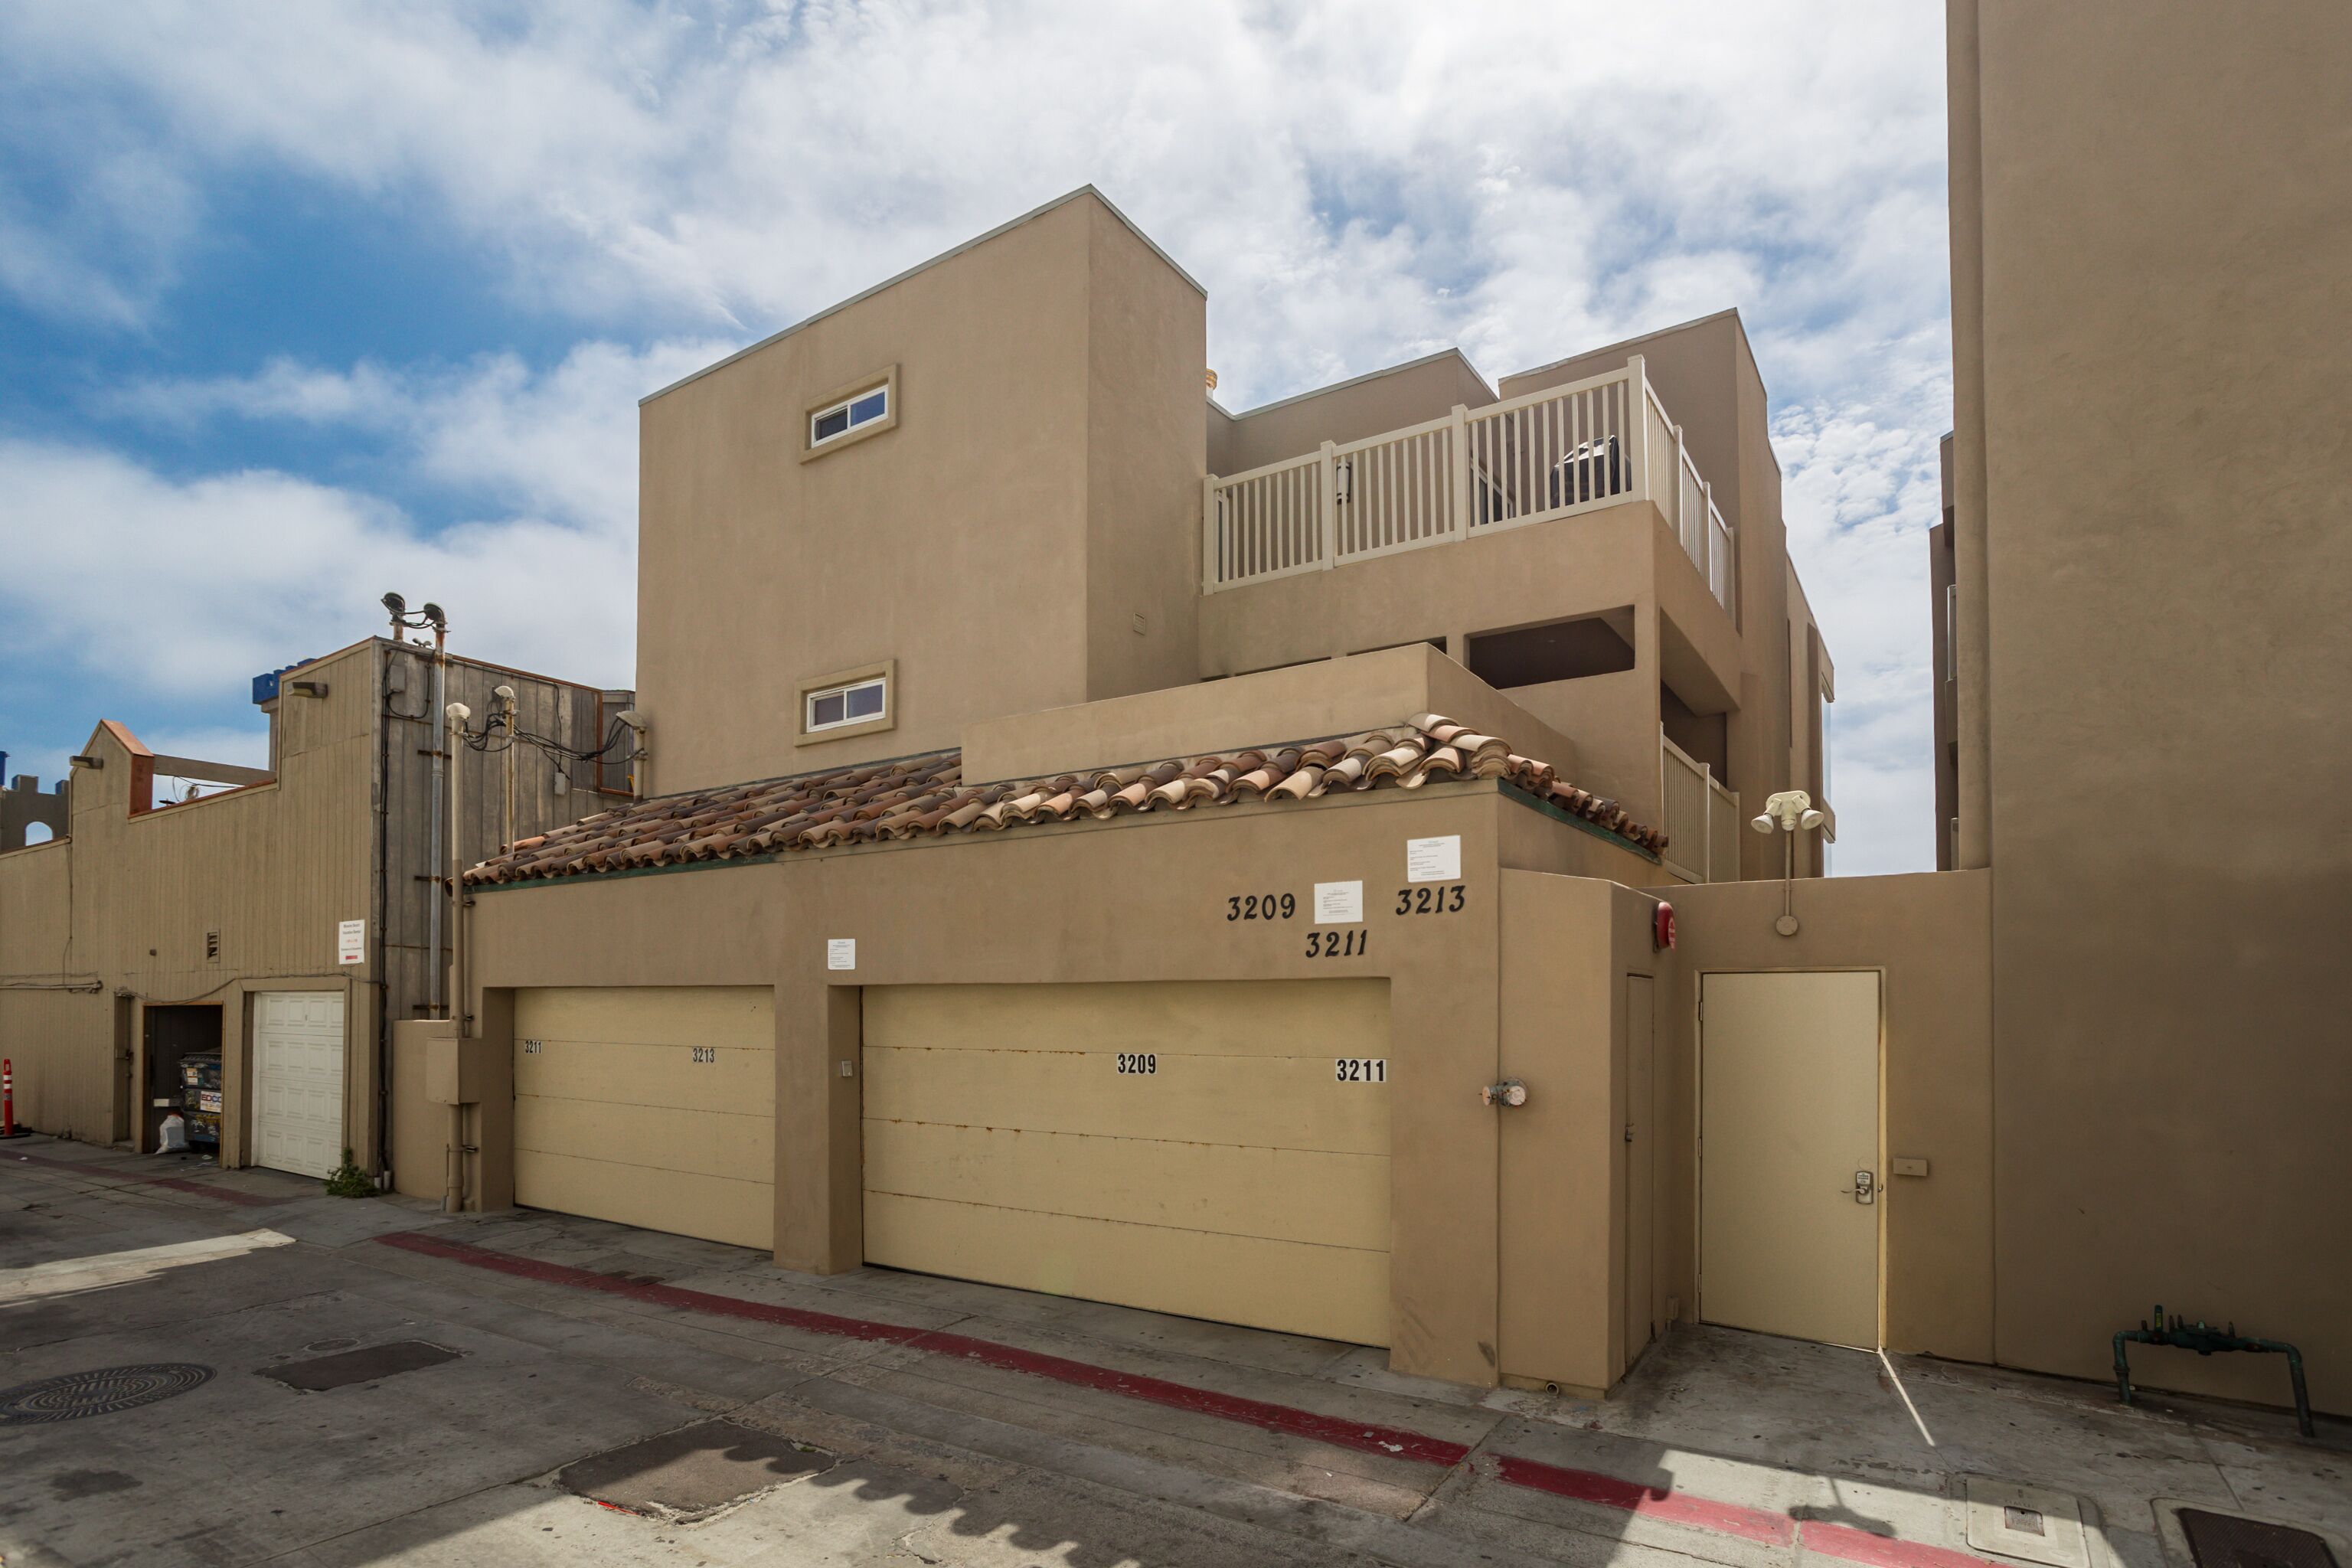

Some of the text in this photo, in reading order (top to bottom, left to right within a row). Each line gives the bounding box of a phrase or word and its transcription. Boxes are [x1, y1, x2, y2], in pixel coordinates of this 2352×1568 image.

[1227, 893, 1295, 922] 3209
[1395, 885, 1465, 916] 3213
[1305, 929, 1367, 959] 3211
[524, 1040, 541, 1054] 3211
[692, 1047, 715, 1063] 3213
[1118, 1054, 1156, 1074] 3209
[1337, 1060, 1383, 1082] 3211
